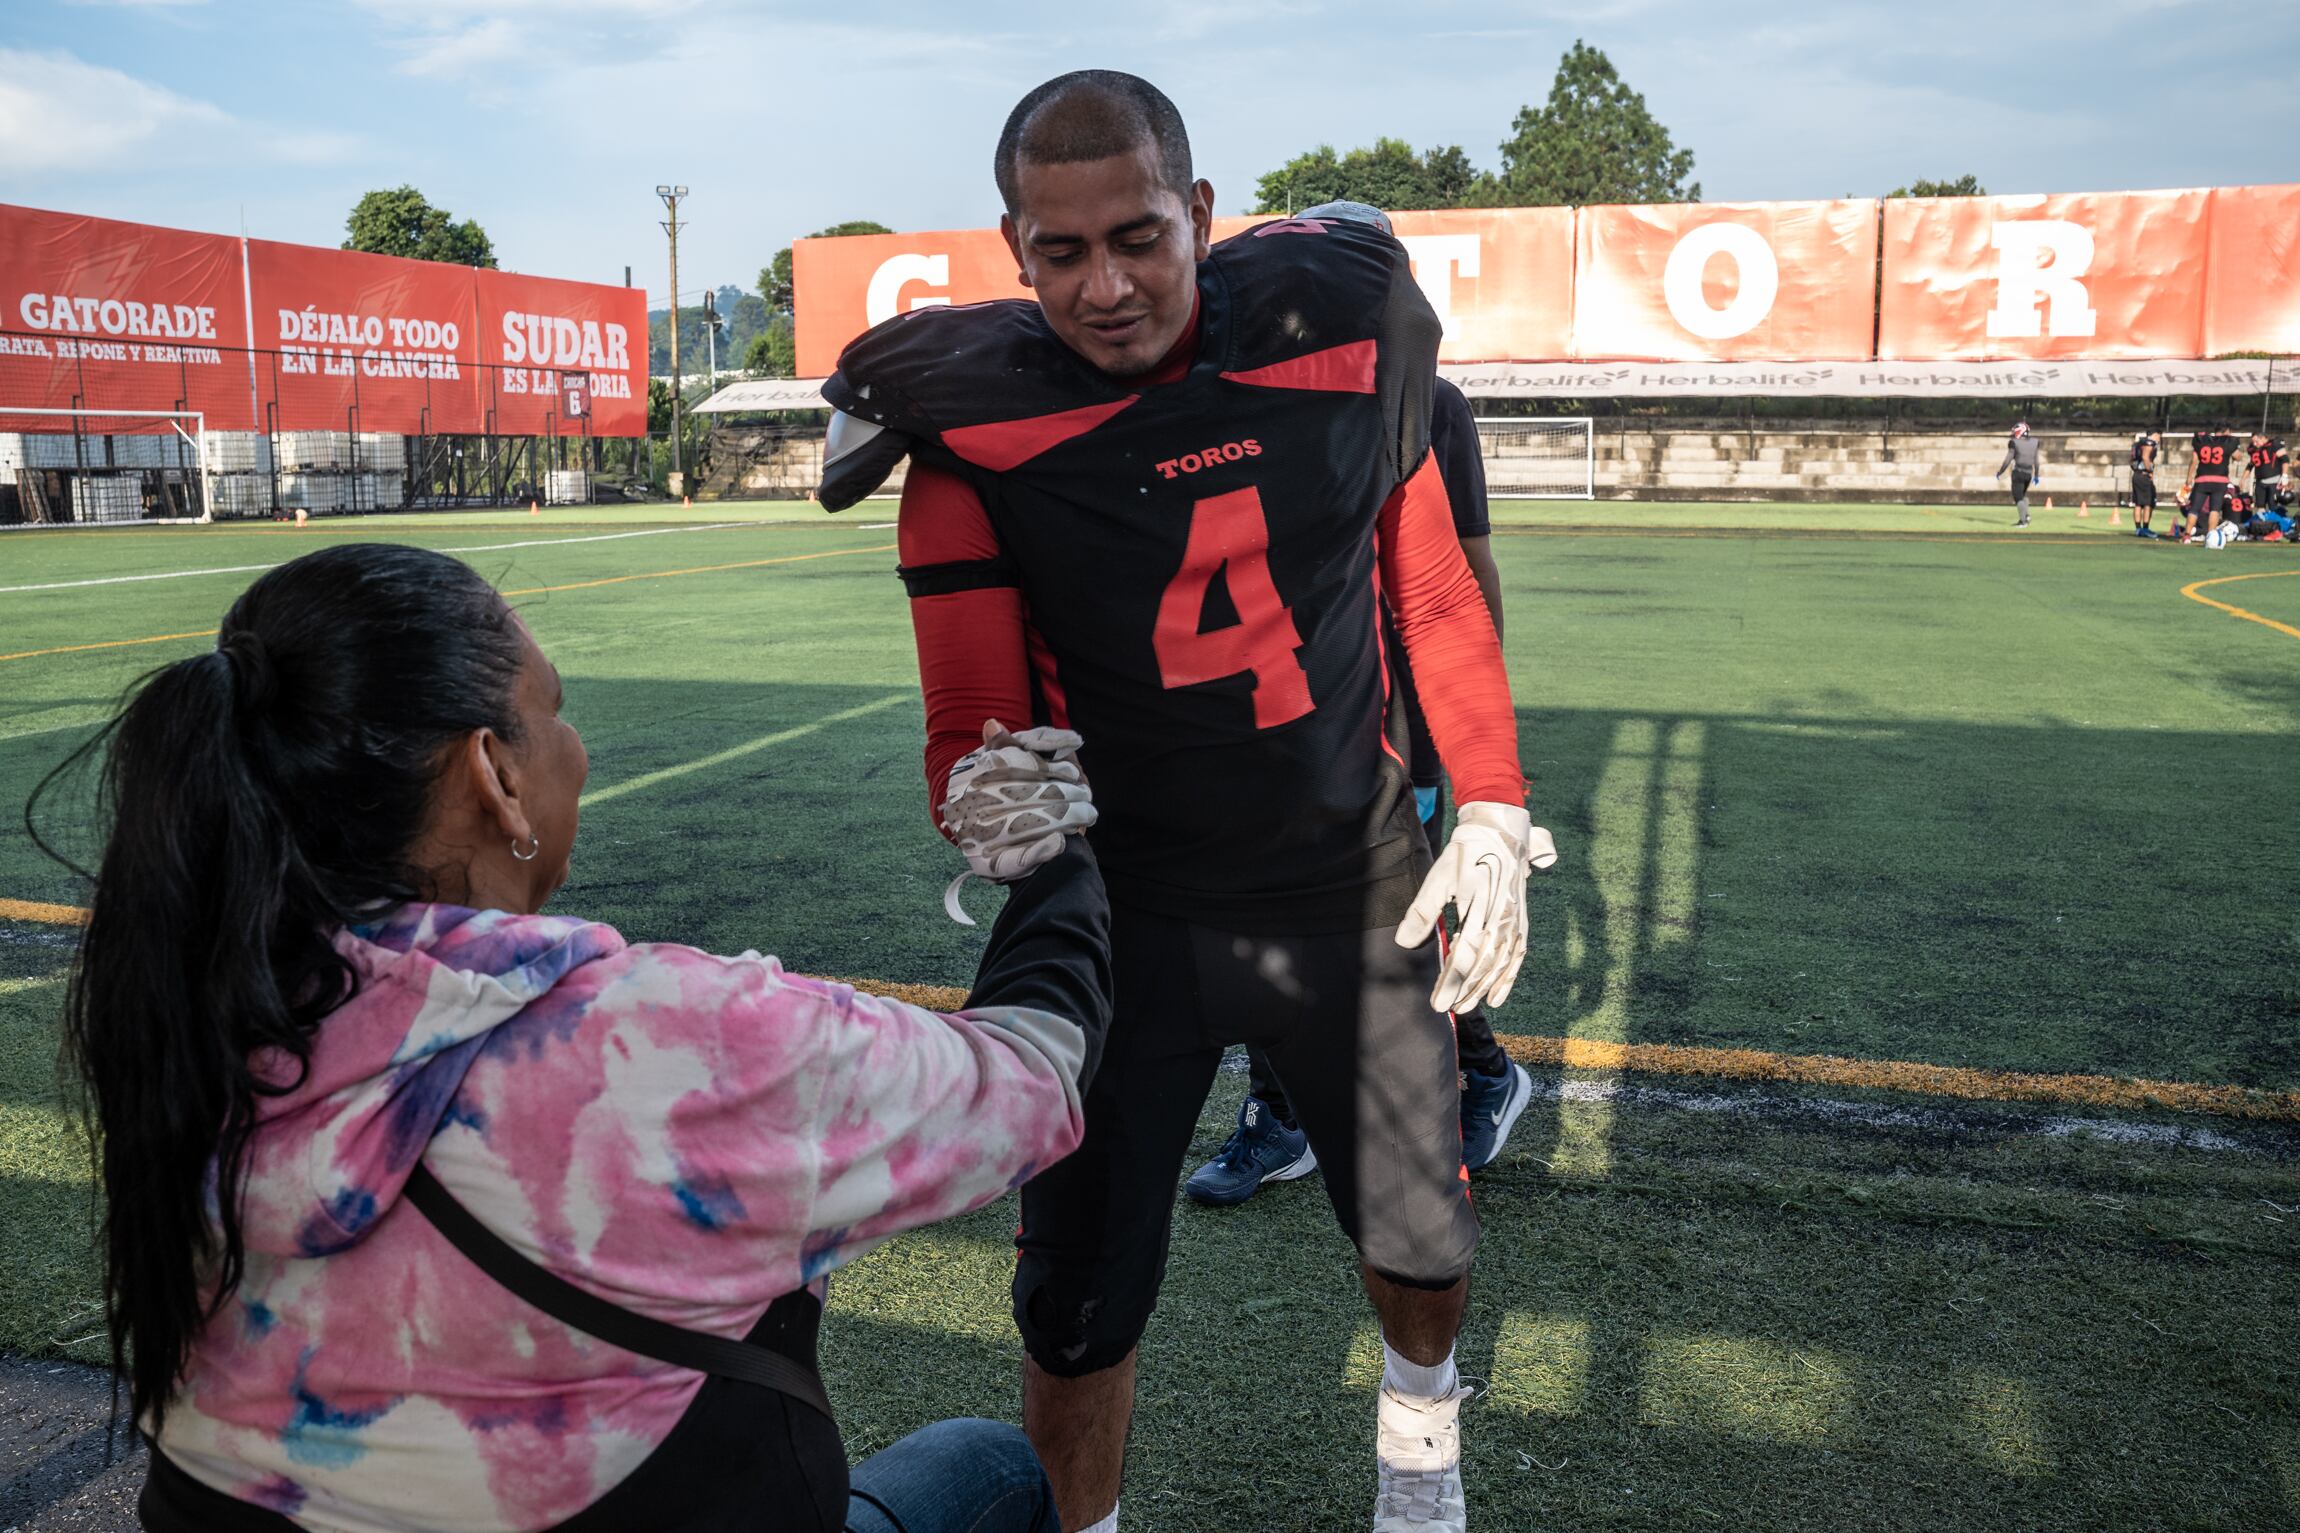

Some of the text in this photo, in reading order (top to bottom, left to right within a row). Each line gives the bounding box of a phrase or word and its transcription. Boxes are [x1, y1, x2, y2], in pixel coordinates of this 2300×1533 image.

[20, 293, 217, 340] GATORADE
[278, 304, 460, 351] DÉJALO TODO
[56, 340, 127, 362] REPONE
[129, 346, 140, 362] Y
[145, 345, 222, 365] REACTIVA
[502, 310, 630, 370] SUDAR
[280, 345, 461, 381] EN LA CANCHA
[503, 367, 632, 399] ES LA ORIA
[1447, 374, 1612, 388] Herbalife
[1640, 373, 1818, 387] Herbalife
[1859, 373, 2046, 386] Herbalife
[2088, 371, 2291, 386] Herbalife
[569, 390, 582, 416] 6
[716, 390, 822, 404] Herbali
[1155, 438, 1263, 480] TOROS
[2200, 445, 2224, 465] 93
[1152, 485, 1317, 730] 4
